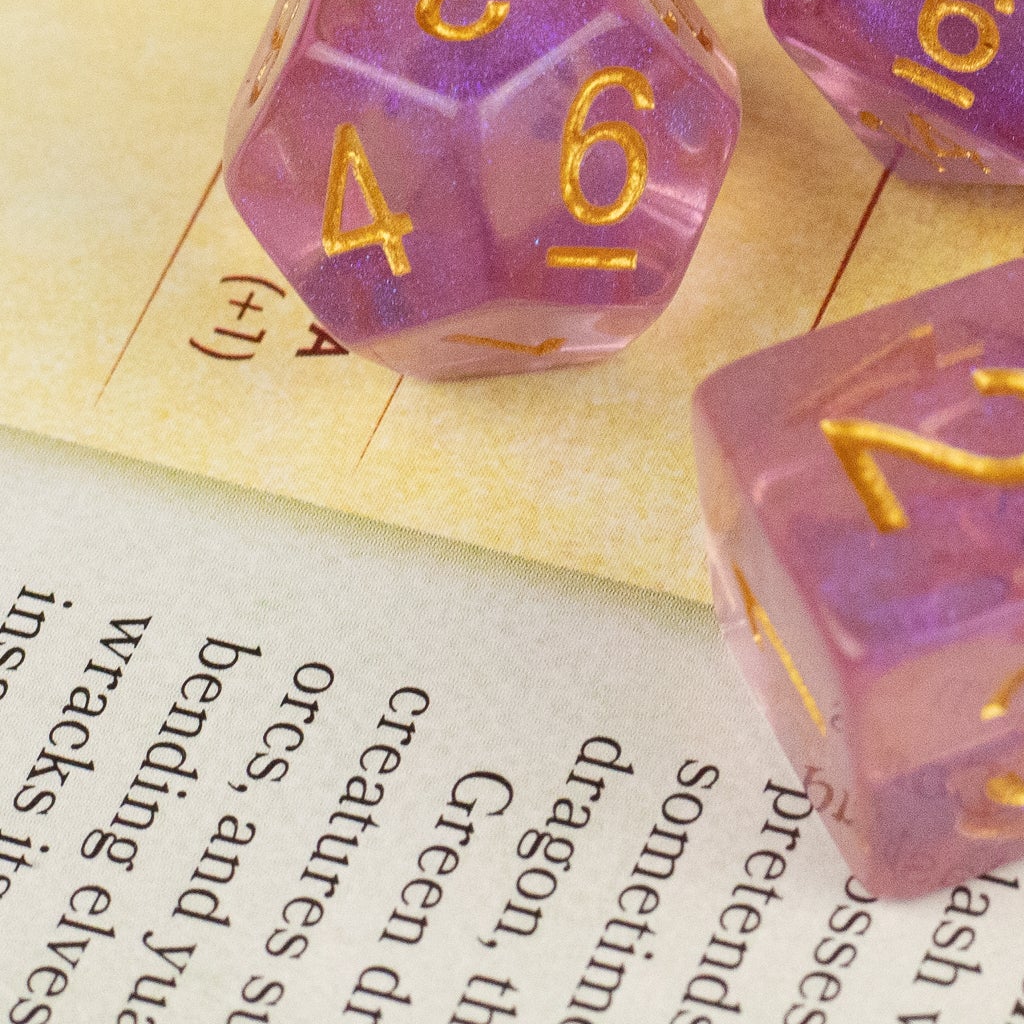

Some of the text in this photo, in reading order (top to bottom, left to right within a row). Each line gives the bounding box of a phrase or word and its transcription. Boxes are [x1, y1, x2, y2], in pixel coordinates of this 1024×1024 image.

[321, 123, 414, 277] 4
[12, 615, 153, 816] wracks
[226, 661, 336, 794] orcs,
[9, 636, 263, 1024] bending elves
[172, 815, 259, 927] and
[266, 686, 432, 959] creatures
[378, 771, 515, 945] Green
[477, 735, 635, 950] dragon,
[559, 758, 720, 1024] sometim
[913, 873, 1021, 987] lash
